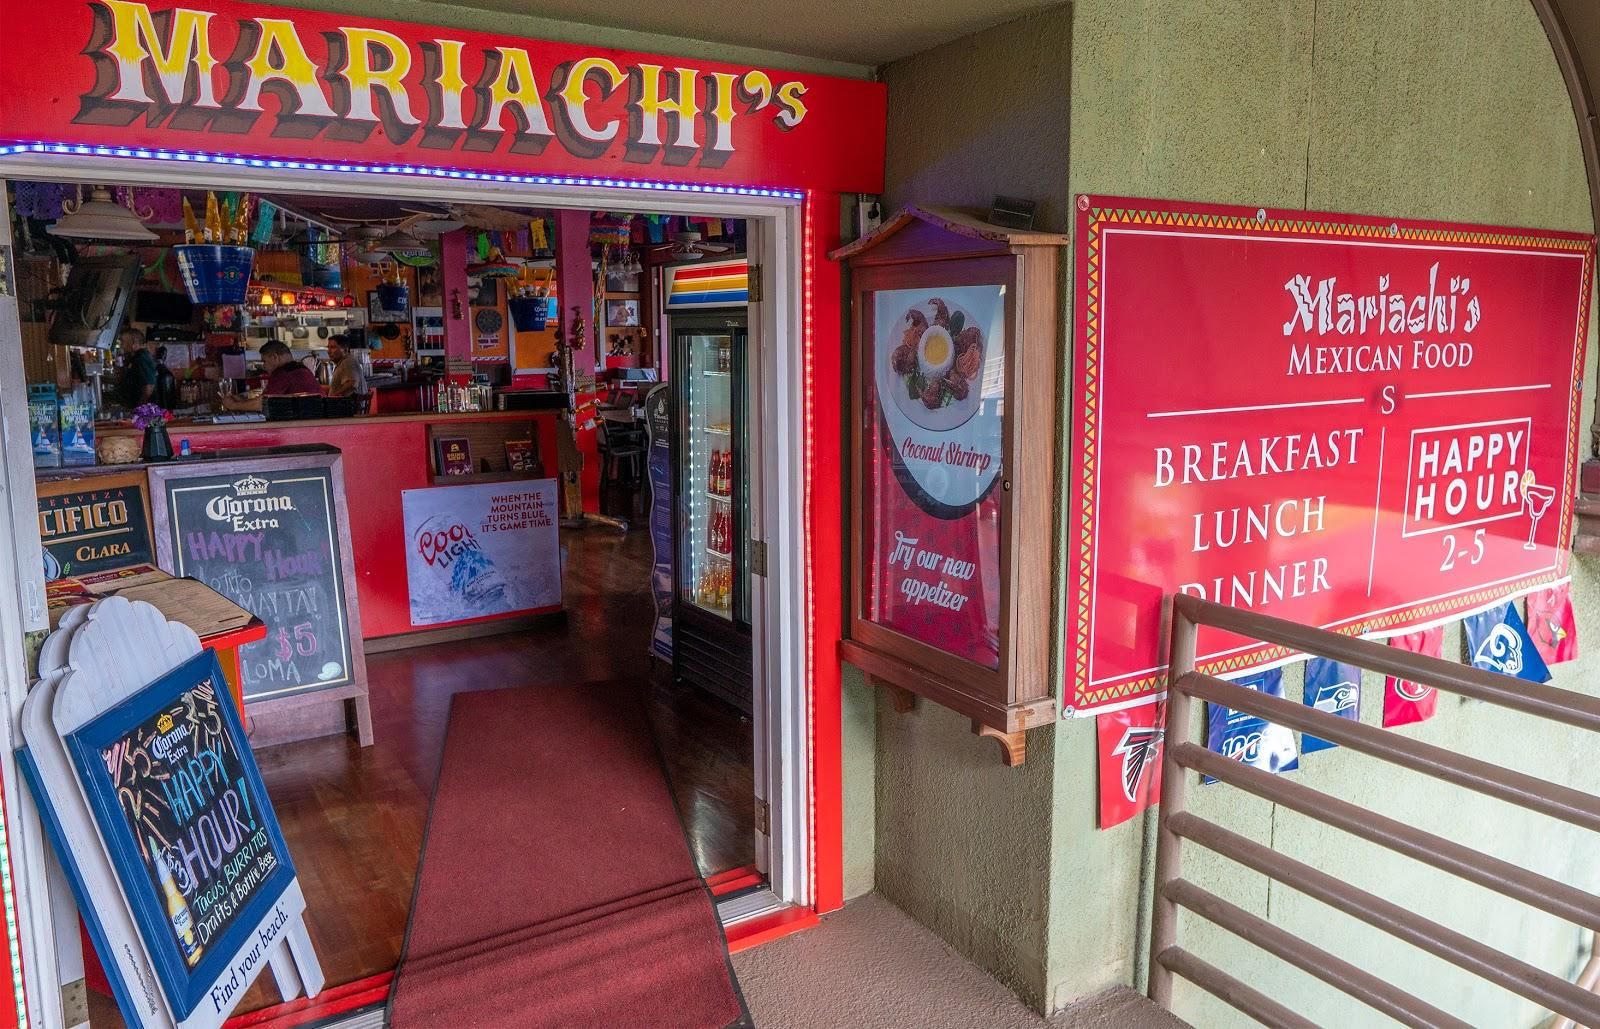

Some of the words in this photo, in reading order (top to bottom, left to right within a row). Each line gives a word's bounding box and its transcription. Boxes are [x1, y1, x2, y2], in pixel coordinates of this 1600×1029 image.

[104, 0, 809, 152] MARIACHI's
[1283, 262, 1481, 336] Mariachi's
[1286, 344, 1403, 376] MEXICAN
[1412, 340, 1473, 370] FOOD
[902, 435, 945, 463] Coconut
[946, 441, 991, 476] Shrimp
[1153, 428, 1364, 488] BREAKFAST
[1418, 430, 1523, 479] HAPPY
[206, 494, 296, 522] Corona
[490, 501, 543, 514] MOUNTAIN
[491, 494, 520, 503] WHEN
[523, 492, 542, 501] THE
[1414, 470, 1519, 523] HOUR
[232, 515, 280, 532] Extra
[487, 512, 519, 524] TURNS
[499, 520, 528, 531] GAME
[1192, 495, 1327, 552] LUNCH
[76, 542, 131, 561] CLARA
[186, 531, 265, 562] HAPPY
[888, 530, 919, 571] Try
[916, 549, 943, 571] our
[941, 556, 976, 581] new
[1440, 528, 1486, 572] 2-5
[901, 577, 969, 612] appetizer
[275, 622, 317, 662] $5
[152, 722, 192, 760] Corona
[167, 744, 189, 766] Extra
[160, 739, 230, 826] HAPPY
[223, 826, 269, 887] BURRITOS
[196, 899, 233, 945] Drafts
[230, 891, 239, 908] &
[209, 966, 241, 1014] Find
[237, 932, 262, 986] your
[258, 907, 290, 951] beach.
